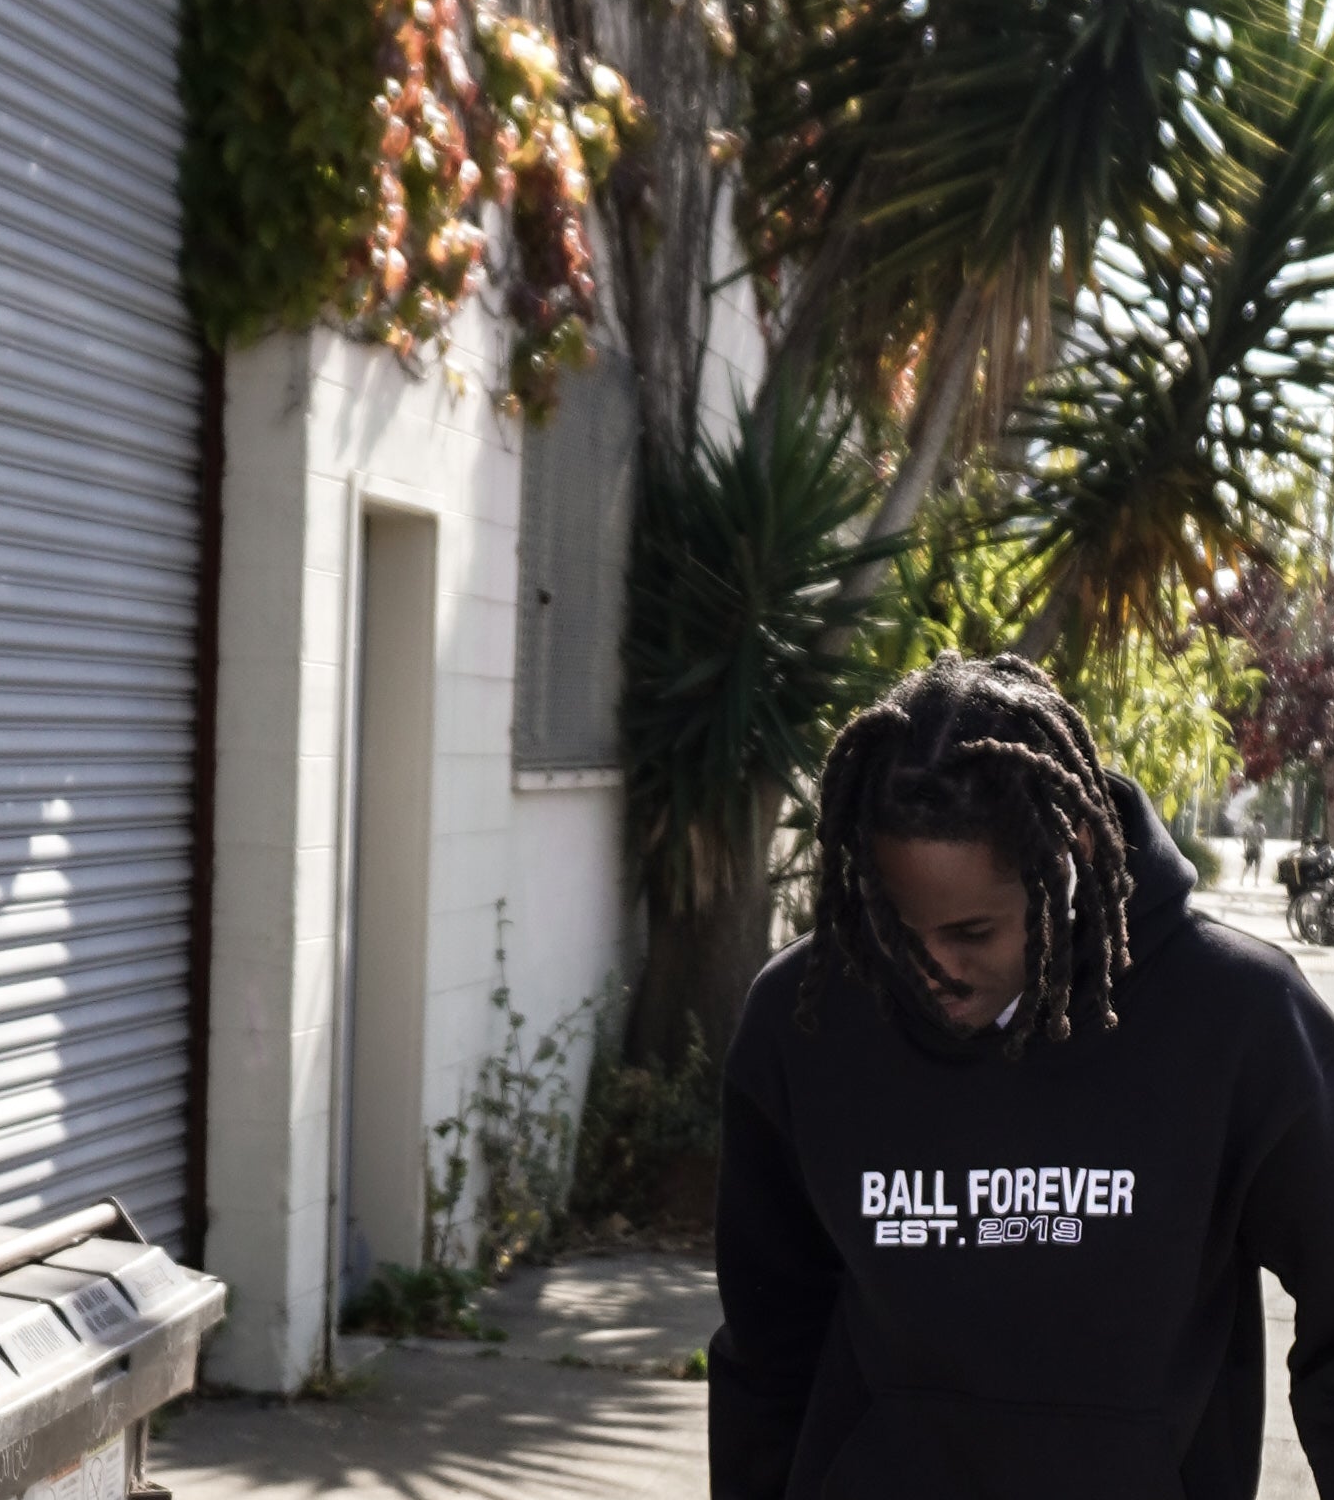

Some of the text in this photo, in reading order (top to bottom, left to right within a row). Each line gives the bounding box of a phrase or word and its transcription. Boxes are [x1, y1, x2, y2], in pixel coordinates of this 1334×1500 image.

[862, 1167, 1135, 1216] BALL FOREVER
[875, 1215, 1082, 1246] EST. 2019
